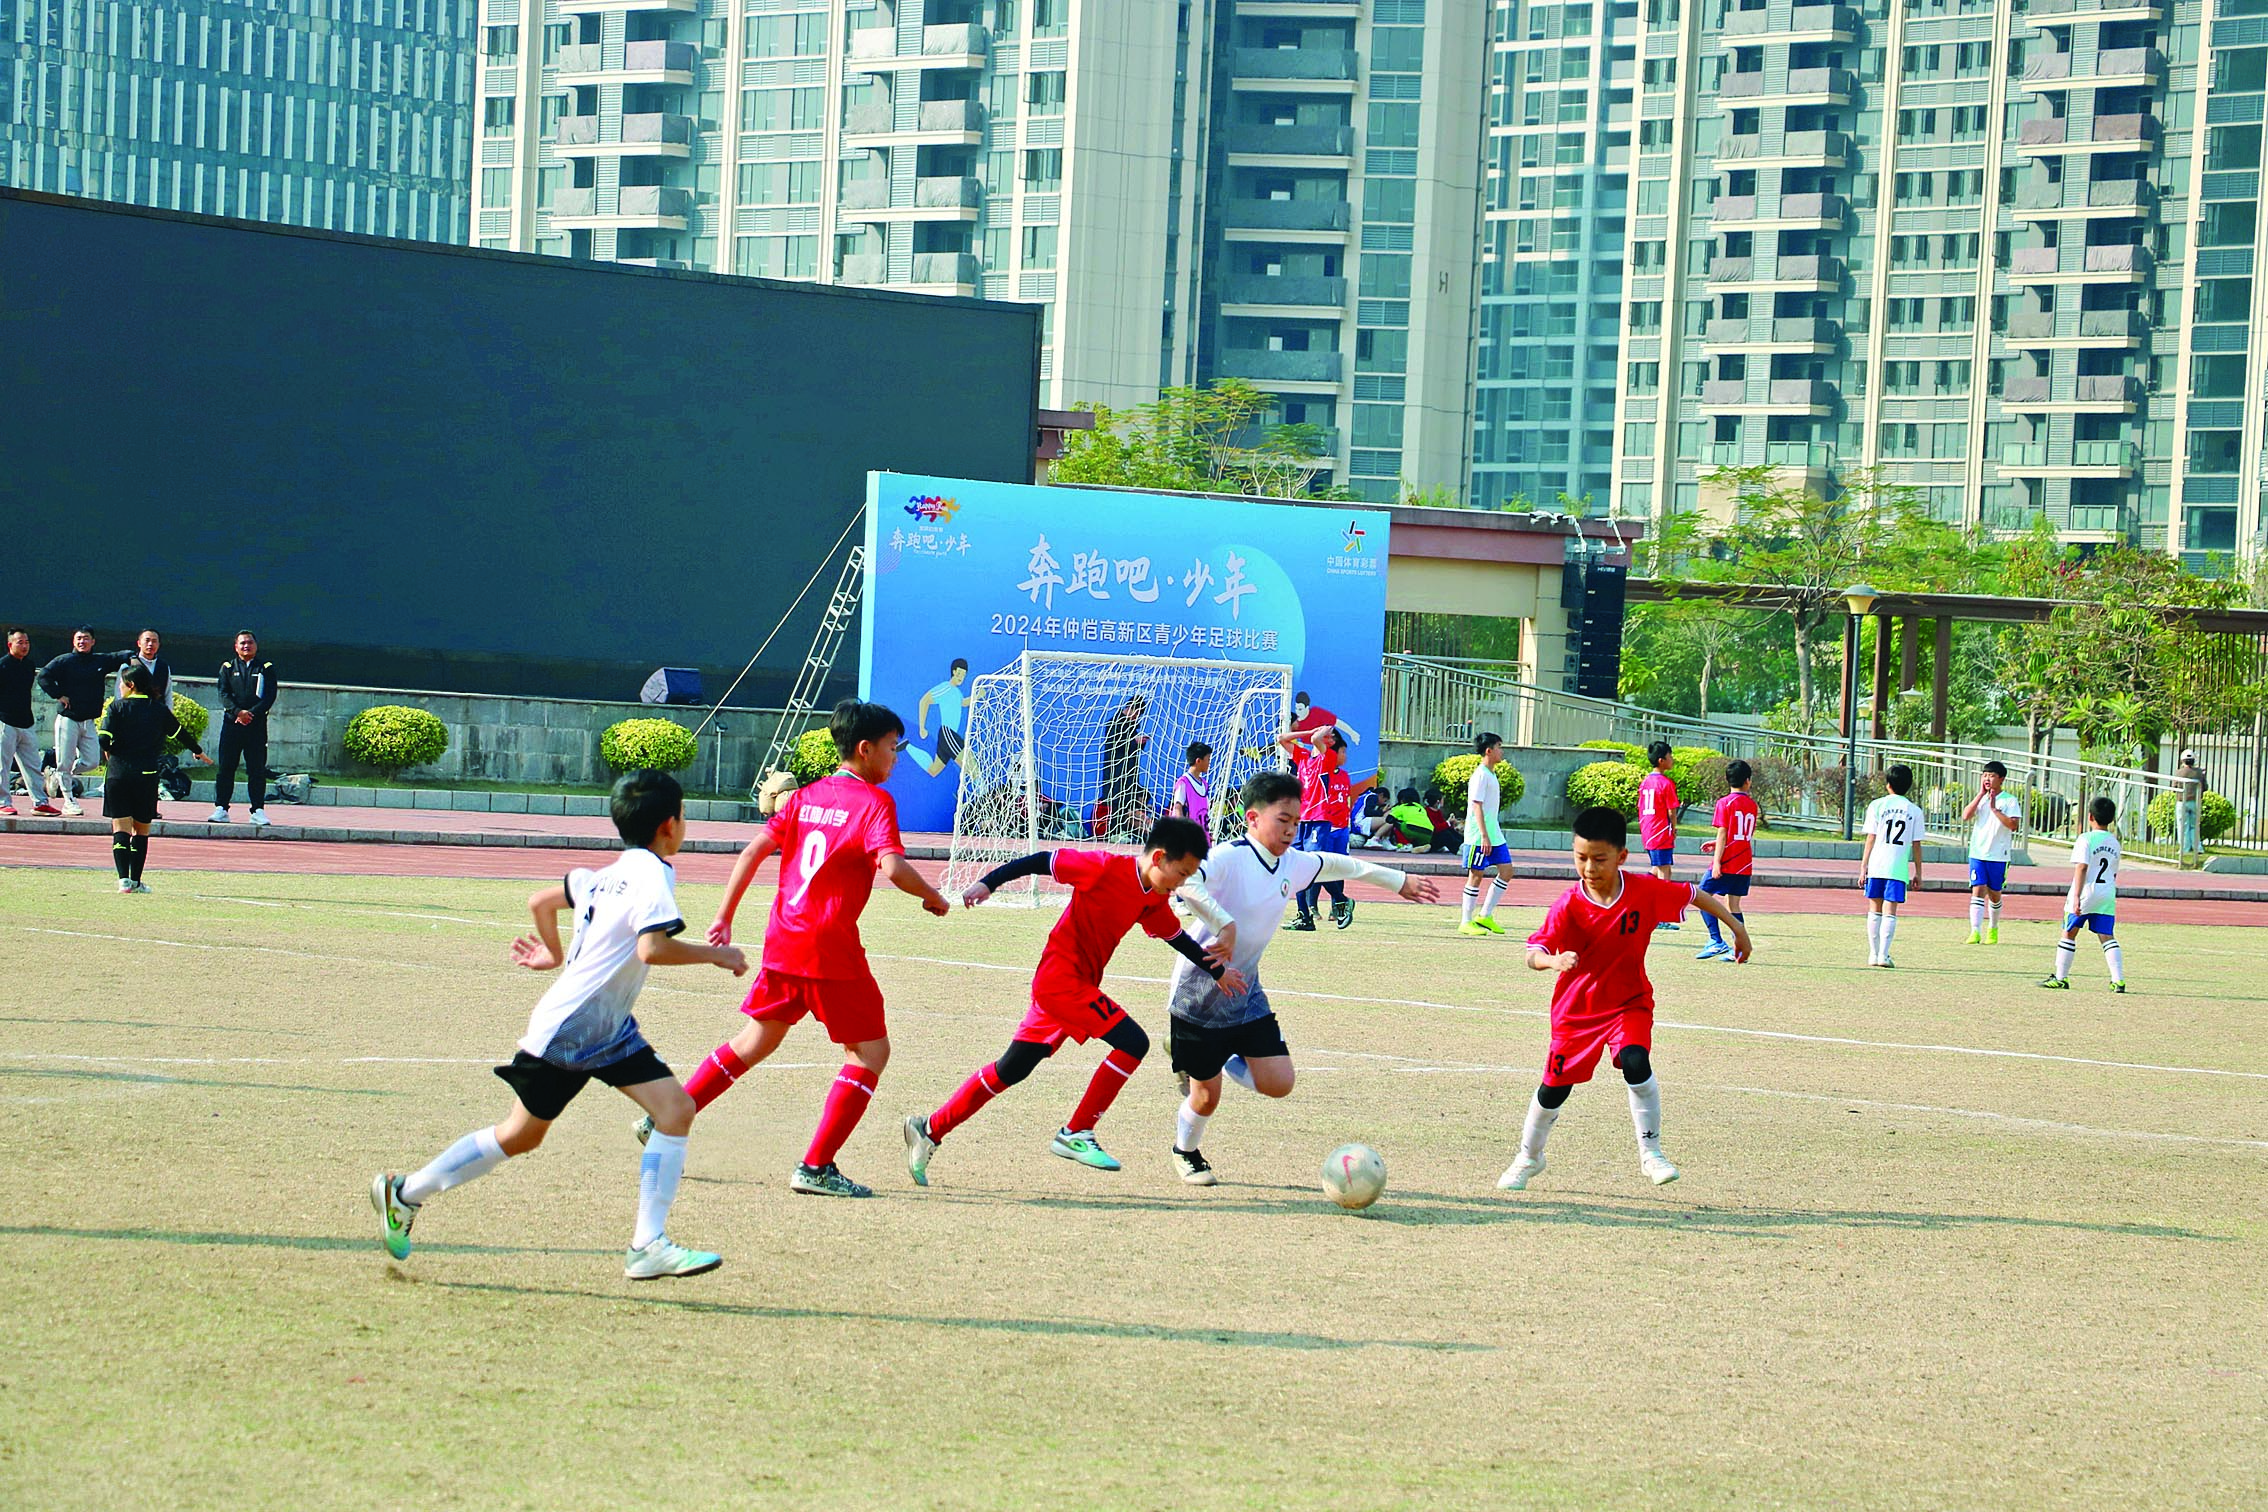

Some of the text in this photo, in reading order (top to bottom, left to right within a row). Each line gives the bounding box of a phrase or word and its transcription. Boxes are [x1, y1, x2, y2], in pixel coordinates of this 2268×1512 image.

[1327, 554, 1377, 569] 中国体育彩票
[1017, 533, 1258, 622] 奔跑吧·少年
[991, 613, 1279, 651] 2024年仲恺高新区青少年足球比赛
[1642, 789, 1656, 816] 11
[1311, 830, 1318, 843] 1
[1734, 811, 1756, 842] 10
[1886, 819, 1906, 846] 12
[788, 830, 827, 906] 9
[1473, 852, 1485, 867] 11
[2095, 857, 2109, 884] 2
[1970, 869, 1977, 881] 6
[1619, 910, 1641, 936] 13
[1089, 995, 1120, 1021] 12
[1547, 1050, 1566, 1076] 13
